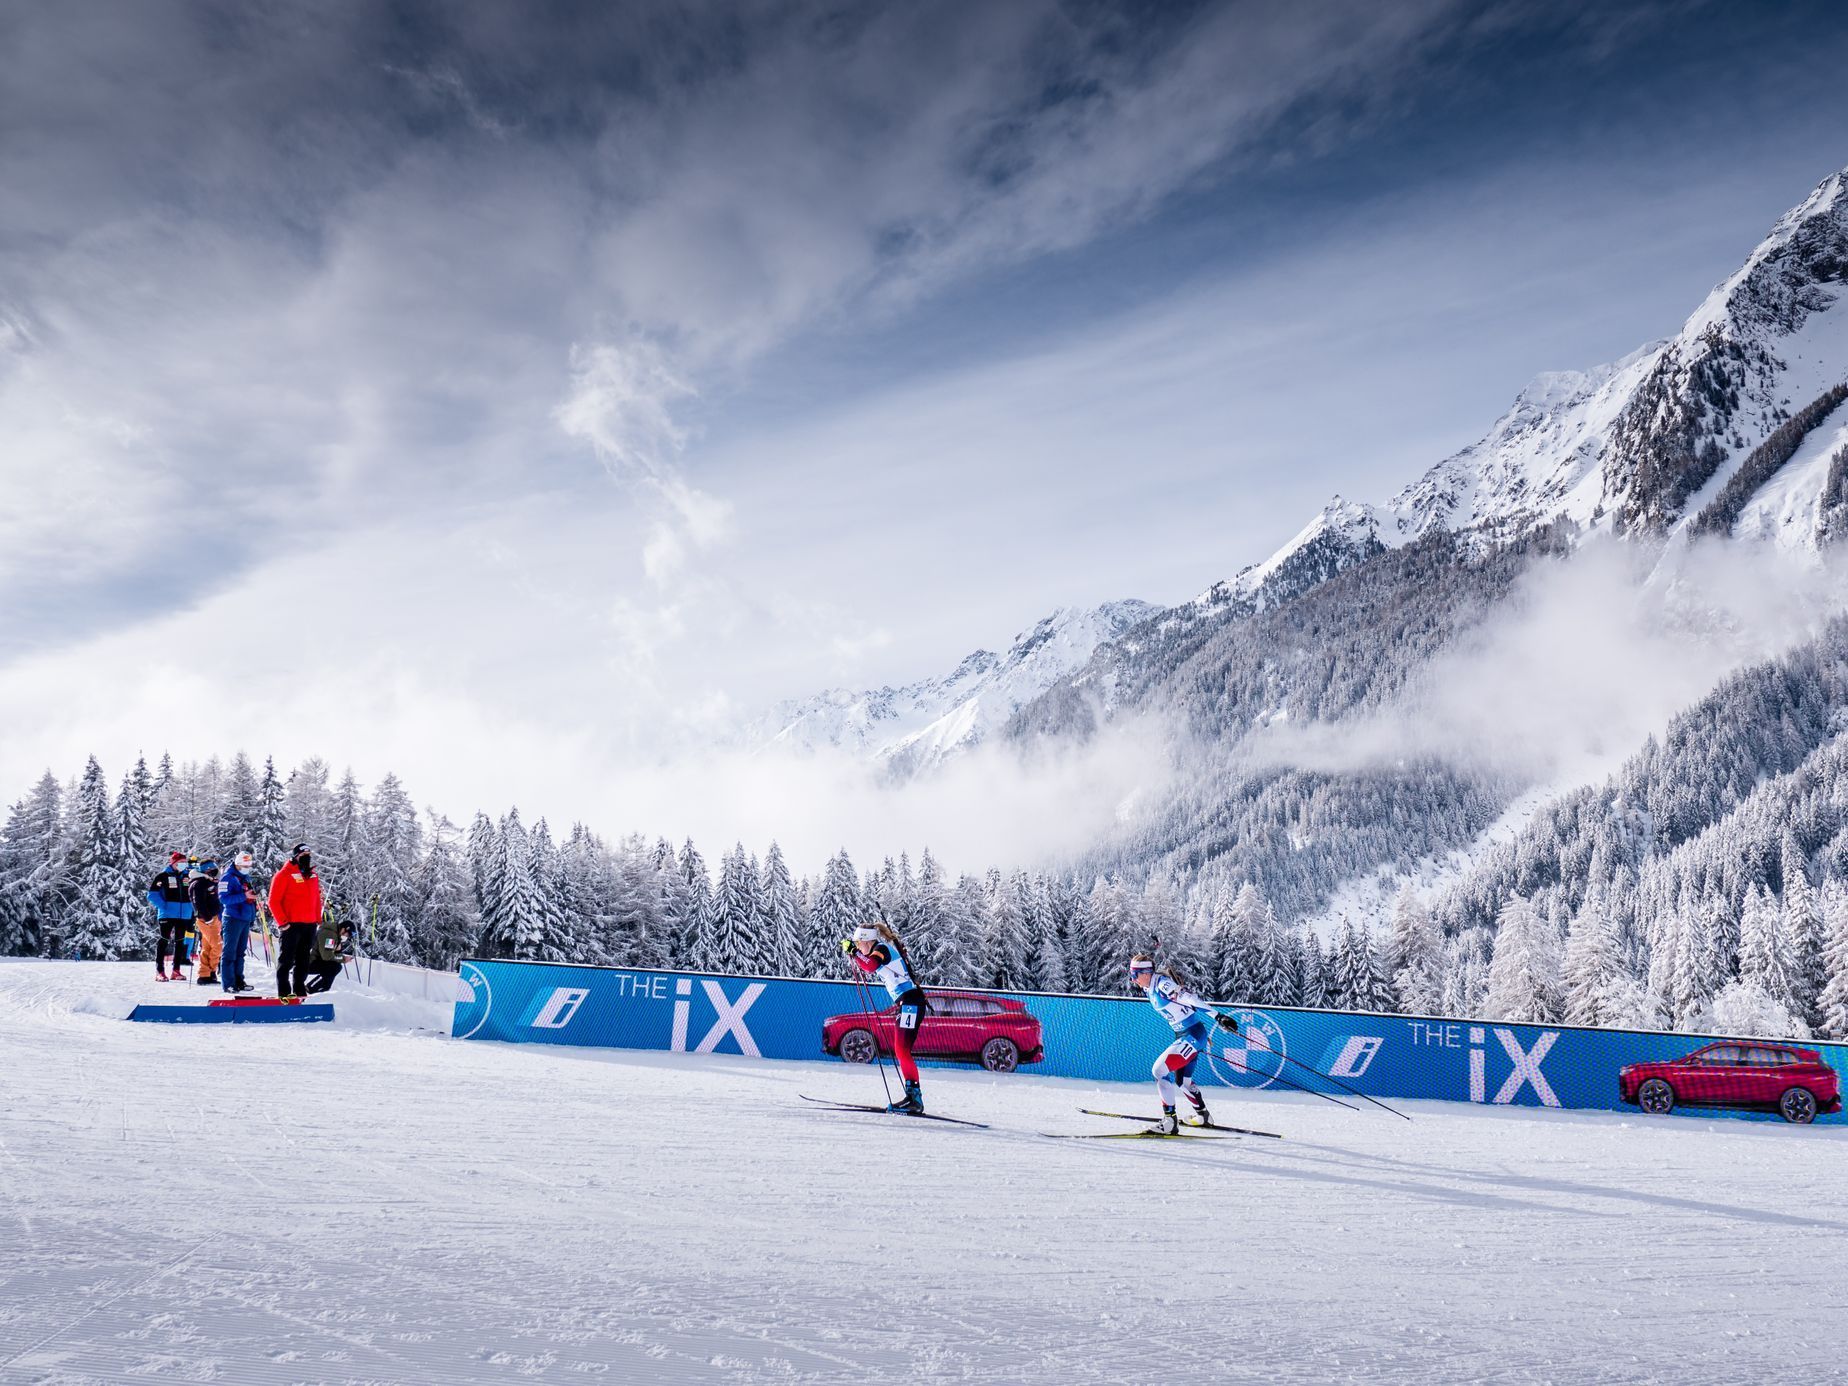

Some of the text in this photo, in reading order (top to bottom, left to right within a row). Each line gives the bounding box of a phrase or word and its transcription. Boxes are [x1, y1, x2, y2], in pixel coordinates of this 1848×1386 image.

[615, 974, 767, 1058] THE iX
[905, 1014, 912, 1028] 4
[1179, 1043, 1193, 1059] 10
[1407, 1022, 1563, 1108] THE iX
